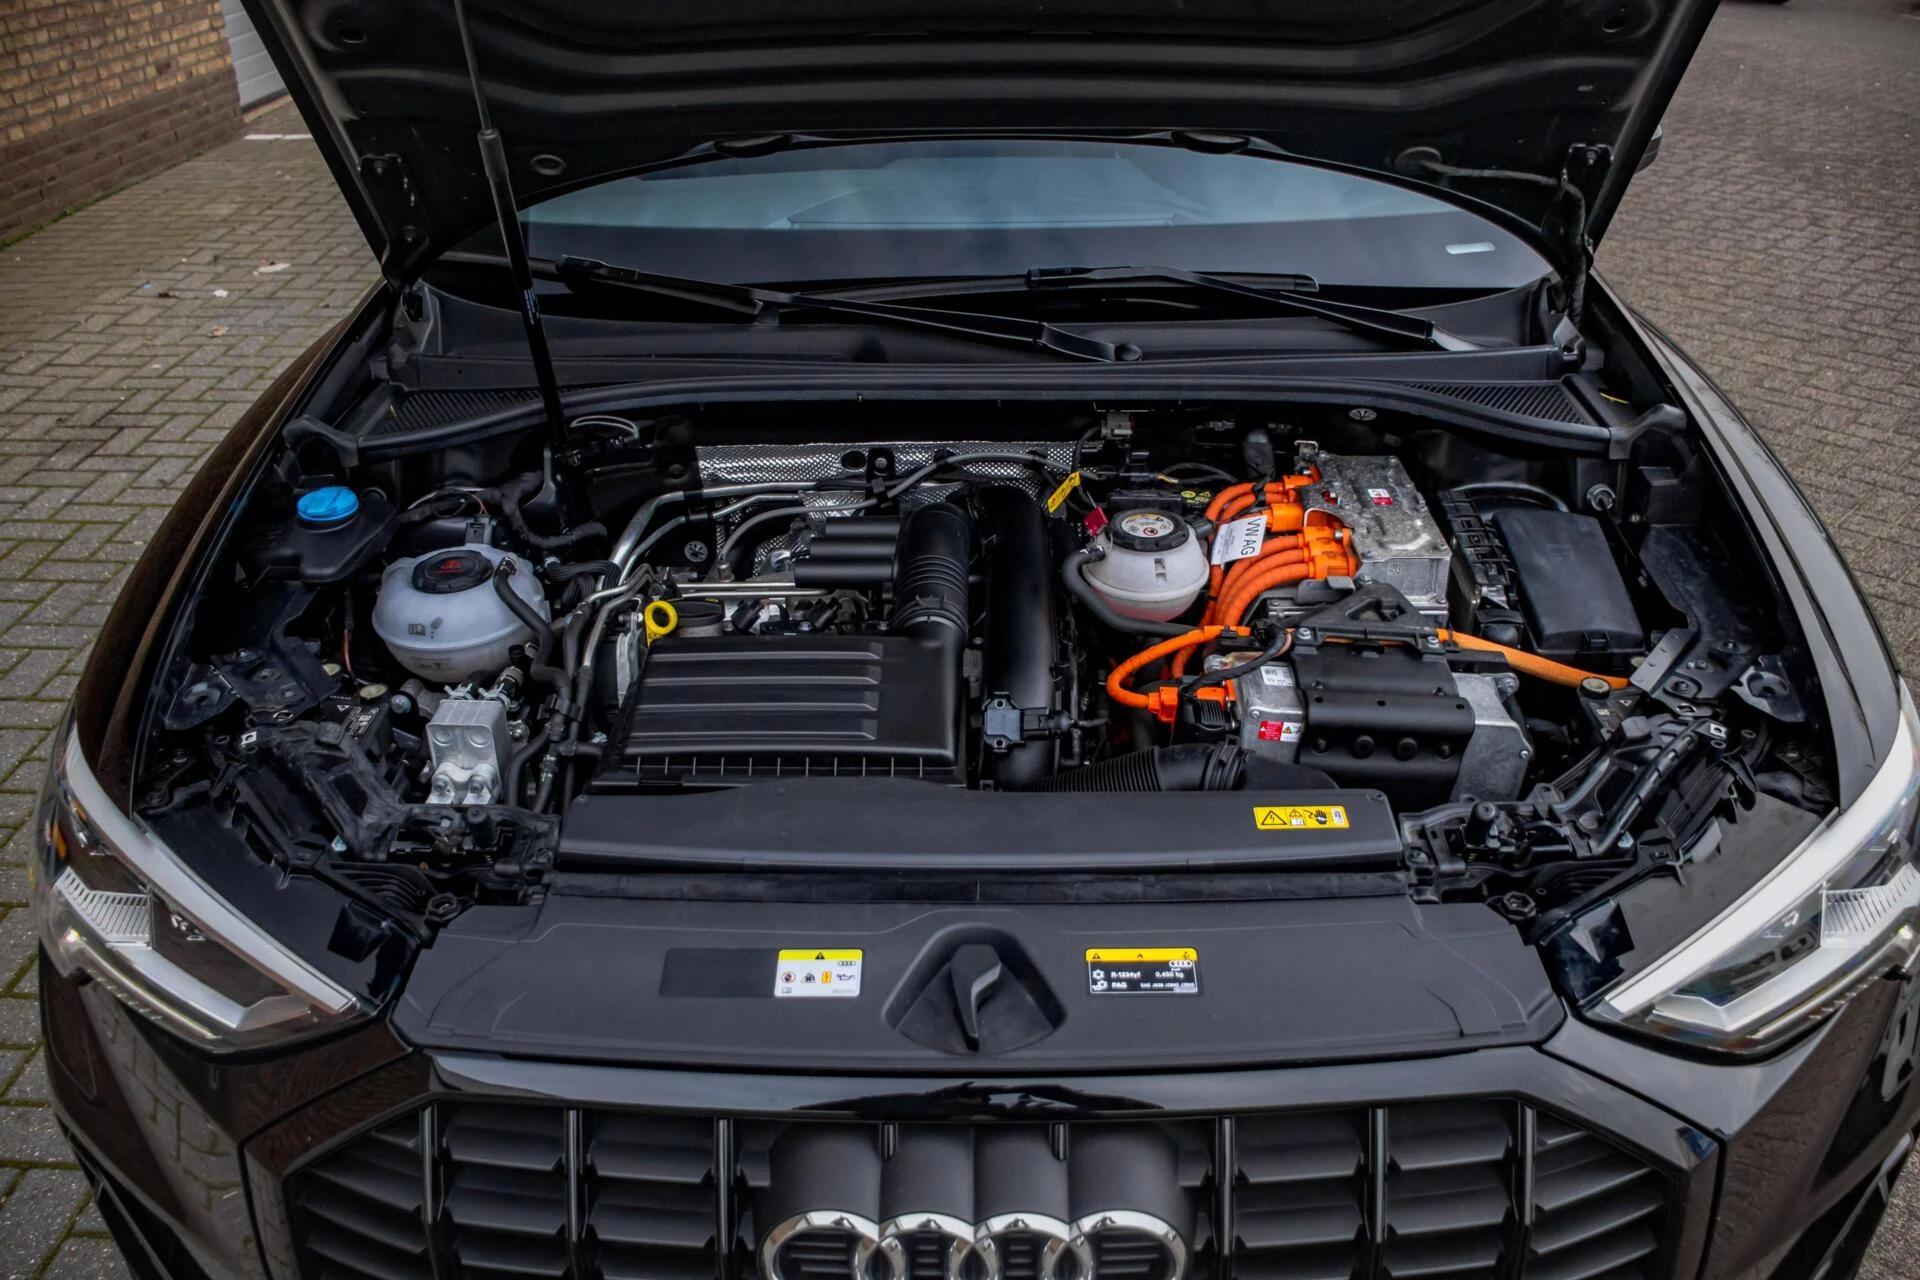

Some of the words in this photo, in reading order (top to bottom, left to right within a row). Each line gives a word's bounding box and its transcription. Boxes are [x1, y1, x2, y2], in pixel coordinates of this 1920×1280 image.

[1245, 518, 1261, 536] VW
[1241, 539, 1256, 555] AG
[1175, 971, 1184, 979] kg
